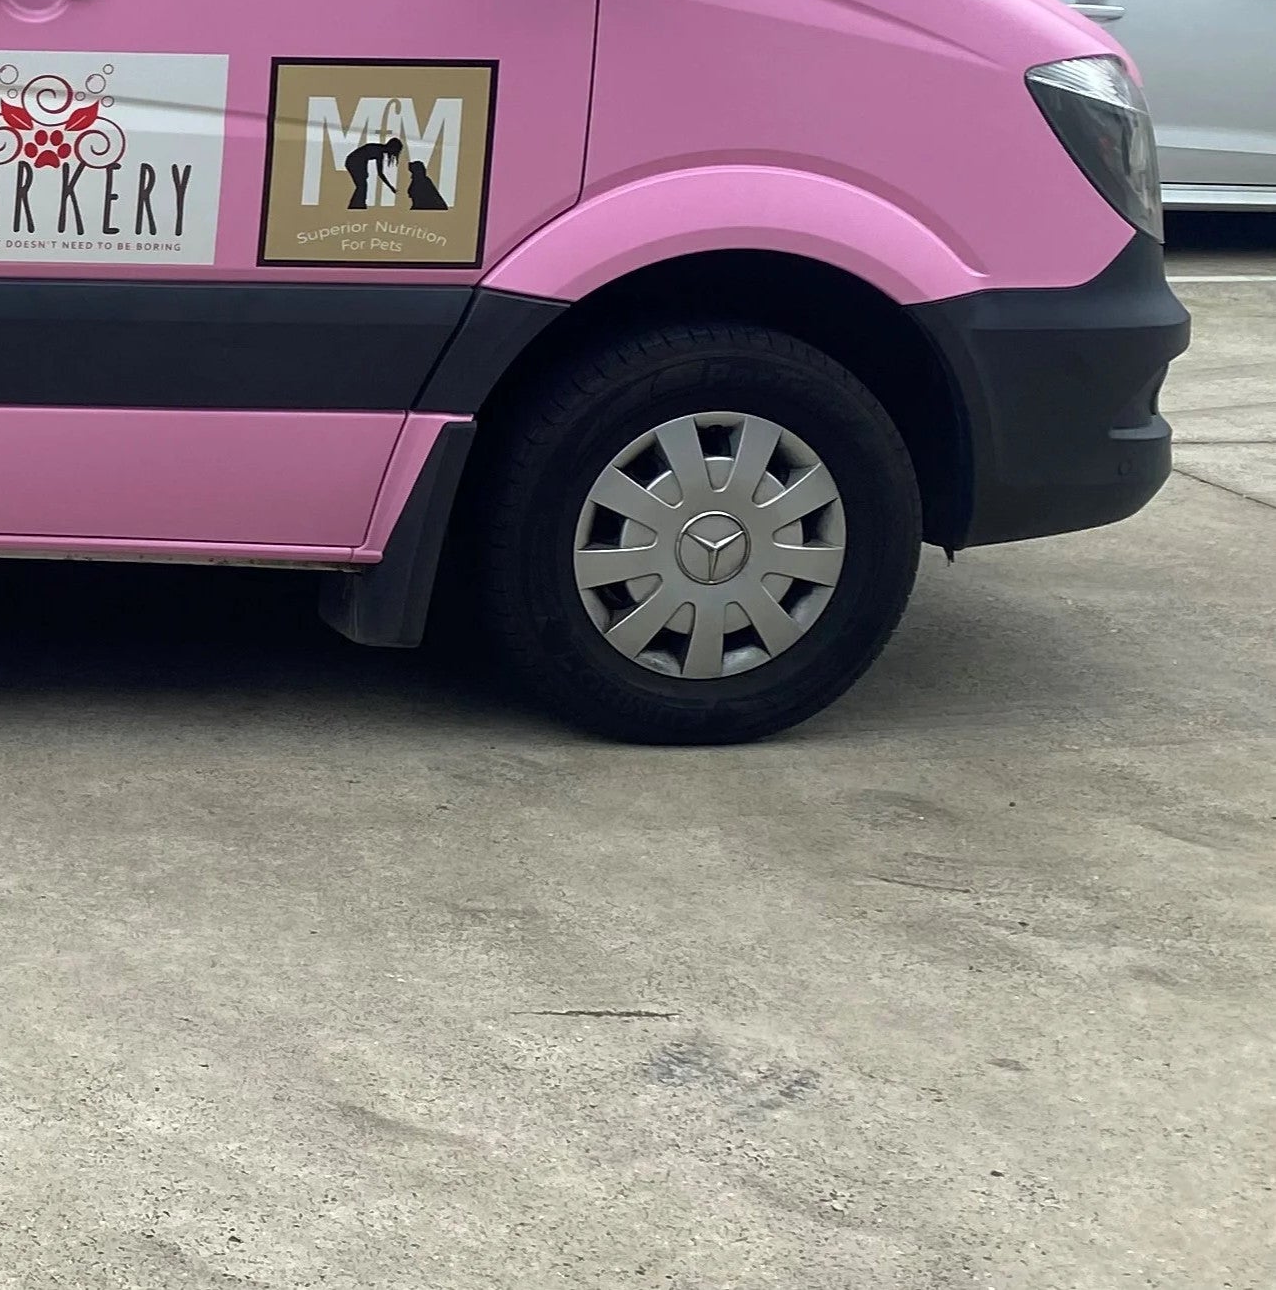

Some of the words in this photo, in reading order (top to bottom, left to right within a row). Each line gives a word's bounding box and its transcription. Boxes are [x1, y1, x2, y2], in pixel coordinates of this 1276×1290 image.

[296, 222, 370, 246] Superior
[375, 220, 448, 248] Nutrition
[61, 240, 94, 250] NEED
[98, 241, 113, 250] TO
[116, 242, 132, 251] BE
[136, 241, 183, 252] BORING
[341, 239, 366, 252] For
[369, 237, 403, 253] Pets
